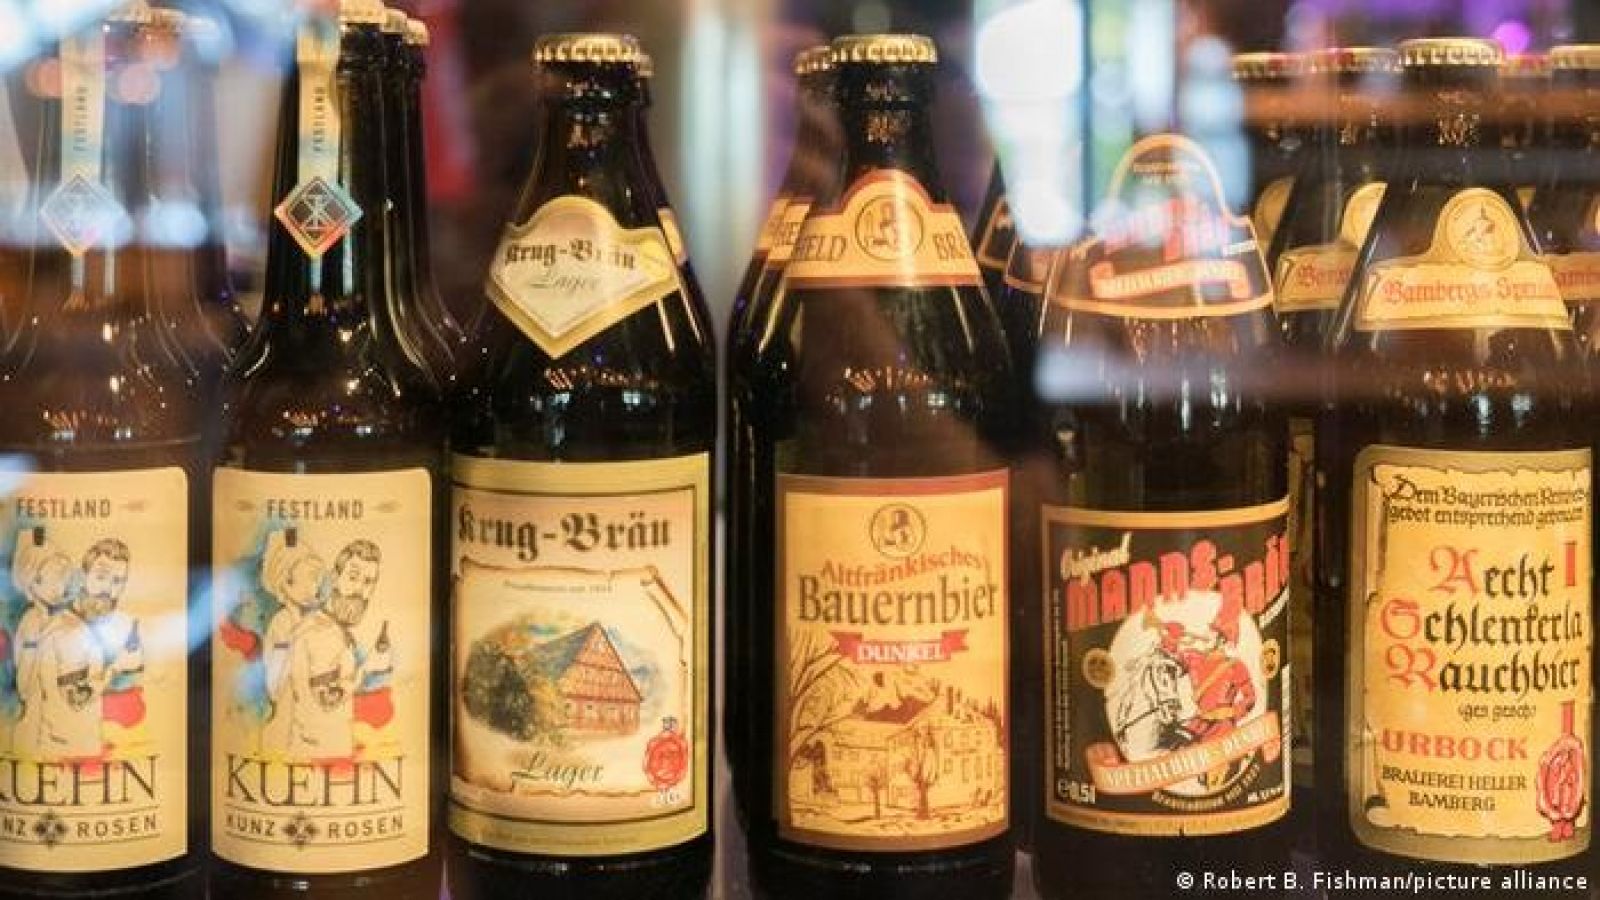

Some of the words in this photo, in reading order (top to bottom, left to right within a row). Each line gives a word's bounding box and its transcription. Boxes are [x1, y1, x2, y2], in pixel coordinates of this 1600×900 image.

[17, 498, 111, 519] FESTLAND
[266, 499, 364, 520] FESTLAND
[457, 503, 671, 562] Krug-Bräu
[819, 545, 984, 590] Altfränkisches
[1428, 544, 1555, 599] Aecht
[797, 574, 998, 626] Bauernbier
[856, 642, 945, 662] DUNKEL
[1385, 643, 1581, 702] Rauchbier
[1382, 727, 1529, 761] URBOCK
[511, 750, 605, 790] Lager
[1382, 764, 1464, 790] BRAUEREI
[1469, 773, 1528, 791] HELLER
[1407, 790, 1496, 812] BAMBERG
[77, 813, 157, 839] ROSEN
[226, 814, 276, 837] KUNZ
[328, 815, 403, 839] ROSEN
